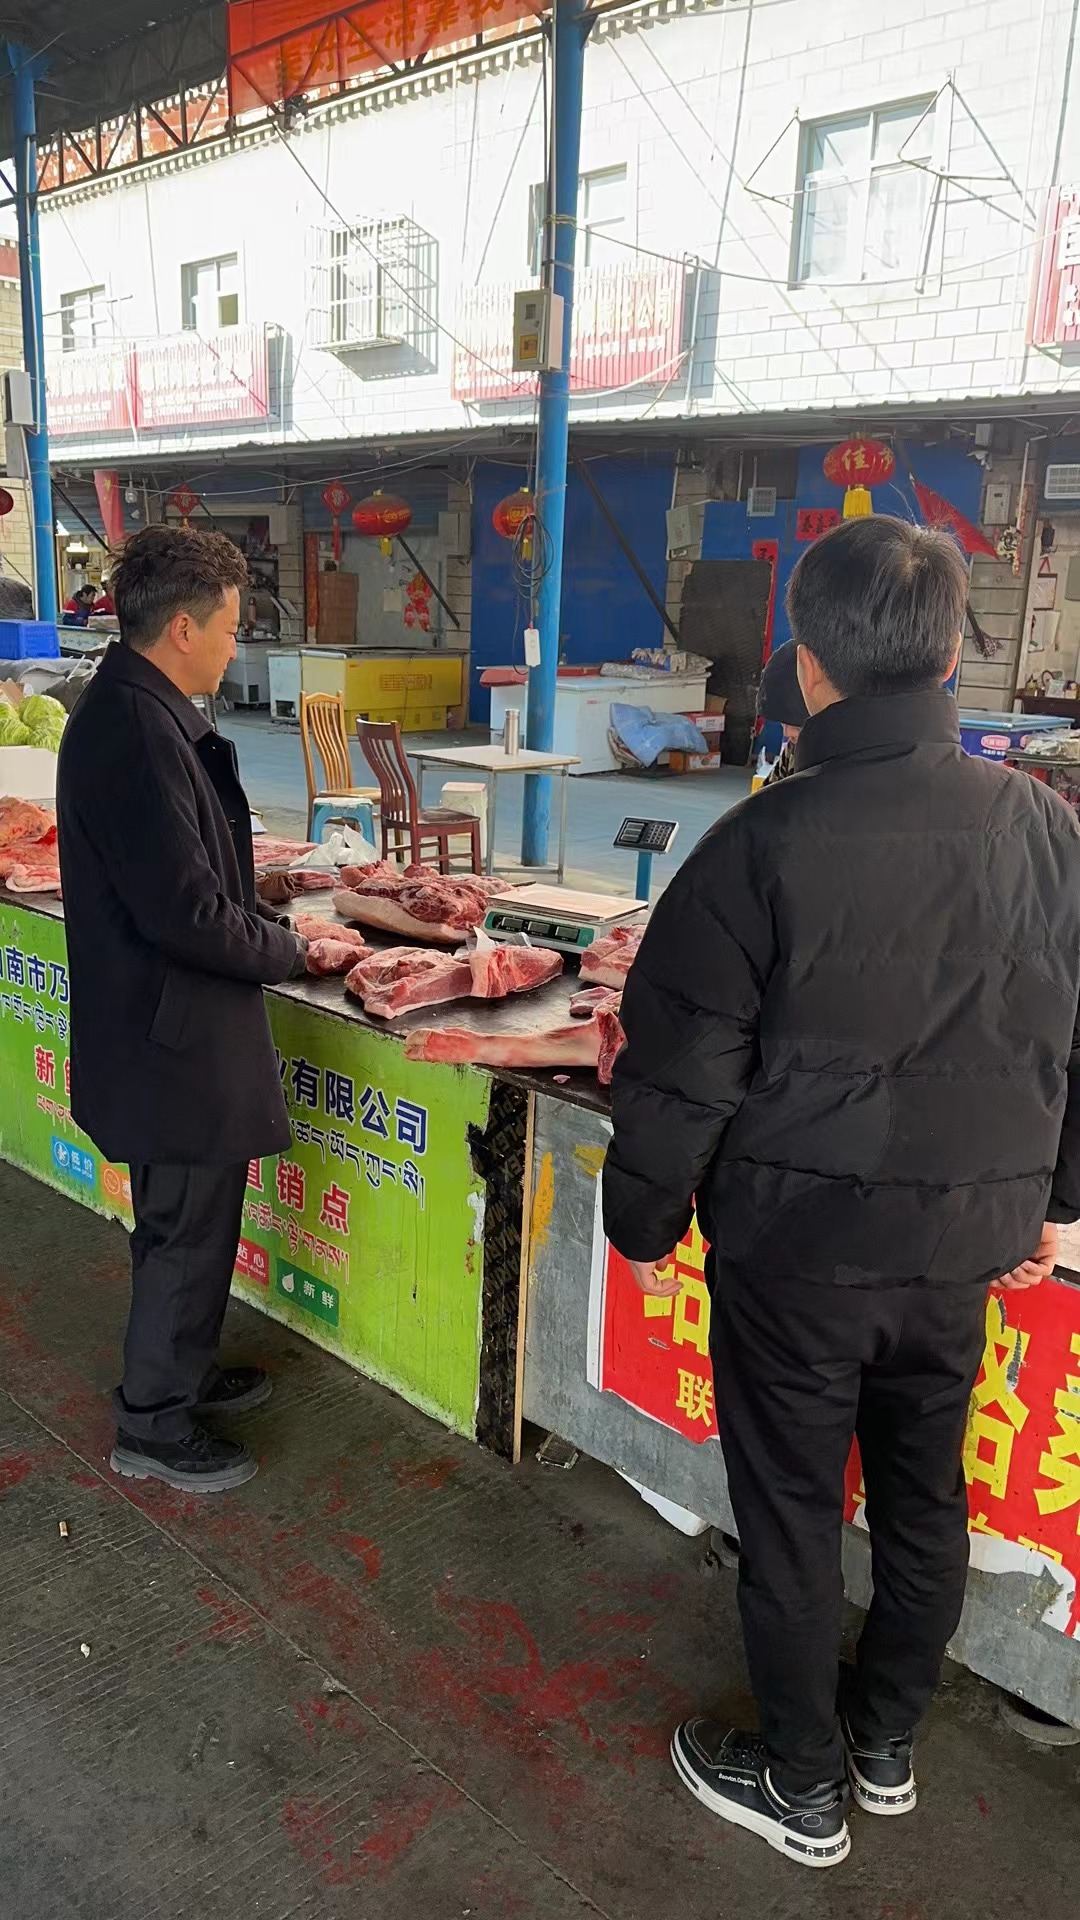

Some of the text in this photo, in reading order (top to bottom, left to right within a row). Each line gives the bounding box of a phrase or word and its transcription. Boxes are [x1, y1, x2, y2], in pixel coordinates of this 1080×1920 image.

[0, 946, 69, 1003] 南市乃
[303, 1280, 334, 1309] 新鲜
